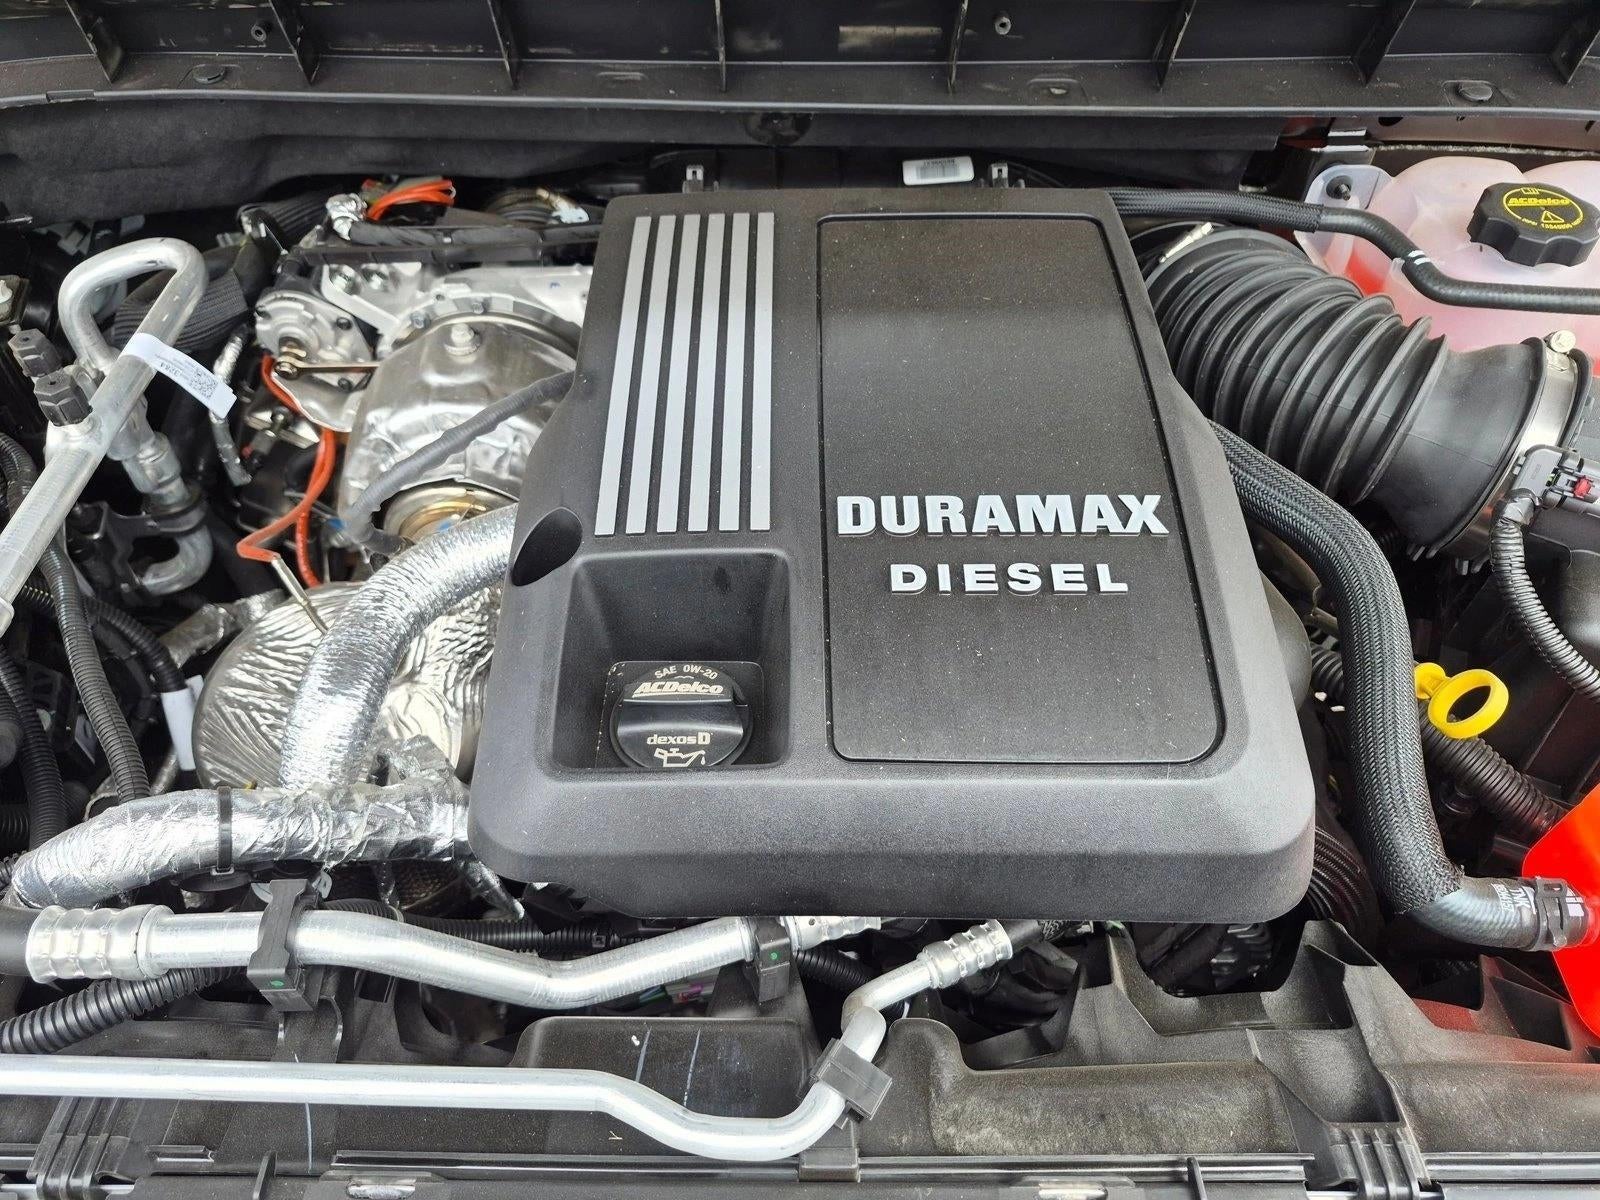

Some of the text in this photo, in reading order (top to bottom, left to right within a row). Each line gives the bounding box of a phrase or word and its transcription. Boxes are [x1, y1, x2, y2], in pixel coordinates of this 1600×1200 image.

[837, 495, 1169, 537] DURAMAX
[890, 563, 1128, 595] DIESEL
[654, 664, 718, 680] SAE 0W-20
[633, 681, 724, 696] ACDelco
[646, 732, 711, 745] dexosD
